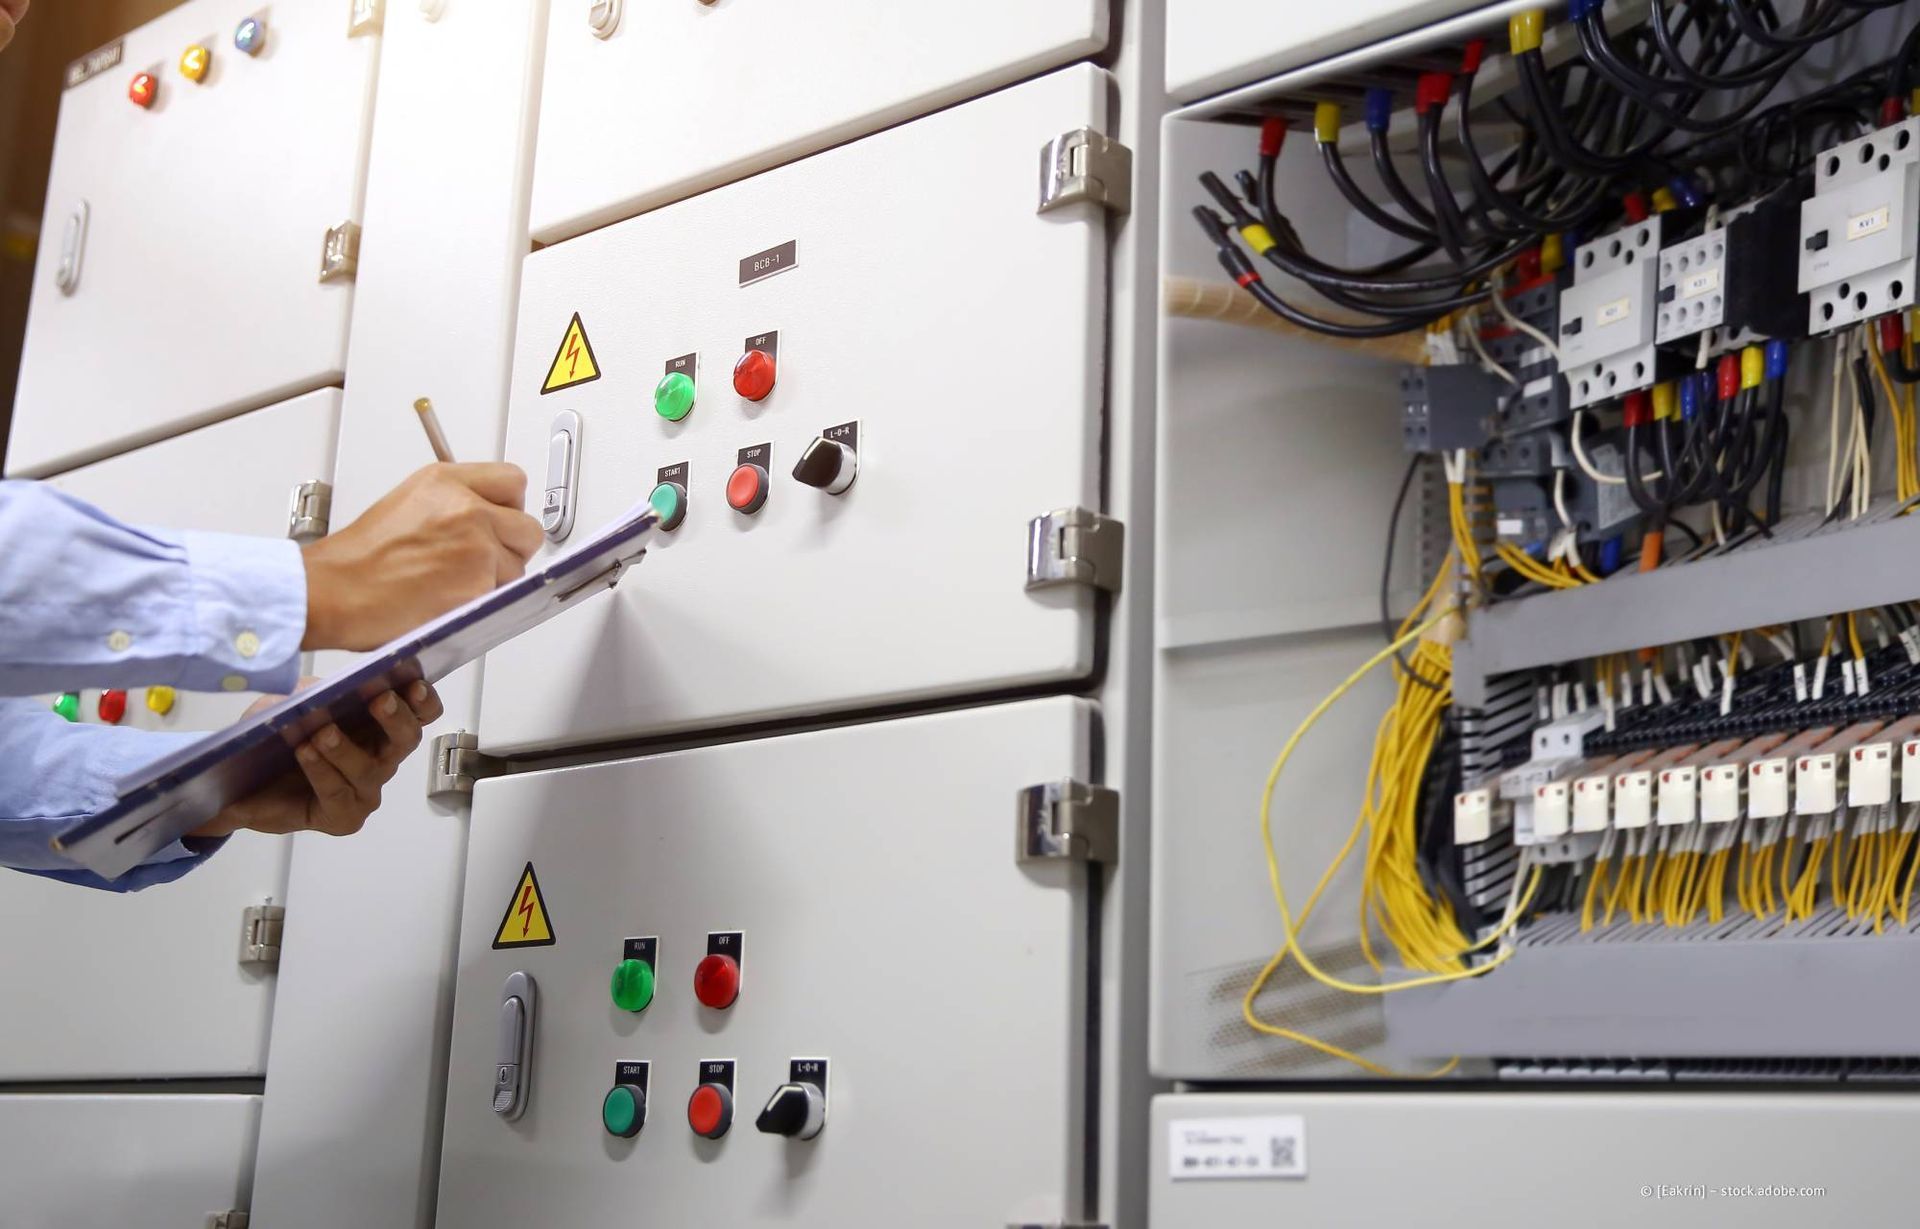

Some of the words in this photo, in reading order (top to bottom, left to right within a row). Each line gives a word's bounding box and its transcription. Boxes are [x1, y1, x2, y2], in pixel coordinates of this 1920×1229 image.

[755, 336, 767, 346] OFF
[675, 359, 686, 368] RUN
[747, 449, 761, 458] STOP
[664, 467, 681, 478] START
[718, 936, 731, 945] OFF
[634, 941, 646, 950] RUN
[623, 1065, 640, 1075] START
[708, 1064, 725, 1074] STOP
